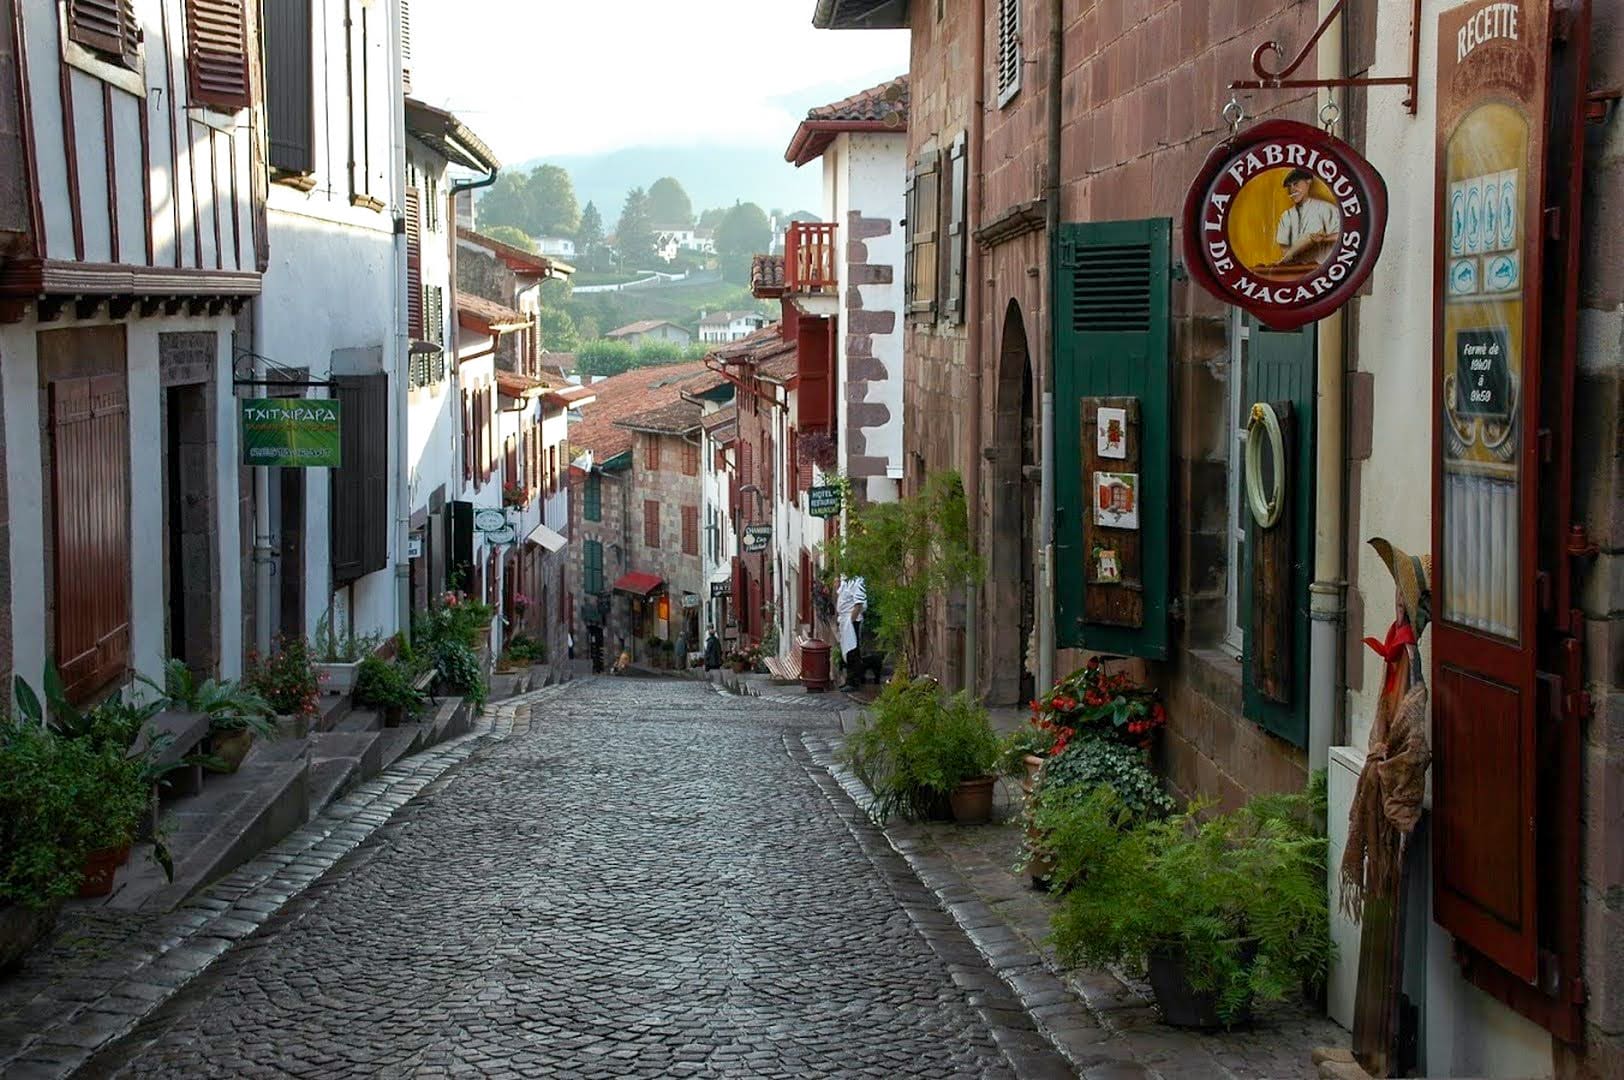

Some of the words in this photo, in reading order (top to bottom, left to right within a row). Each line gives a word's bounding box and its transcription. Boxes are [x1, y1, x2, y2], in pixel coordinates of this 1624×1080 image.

[1457, 3, 1519, 64] RECETTE
[1205, 192, 1231, 232] LA
[1228, 143, 1362, 217] FABRIQUE
[1209, 240, 1235, 276] DE
[1231, 231, 1361, 304] MACARONS
[1488, 342, 1500, 356] de
[244, 408, 336, 421] TXITXIPAPA
